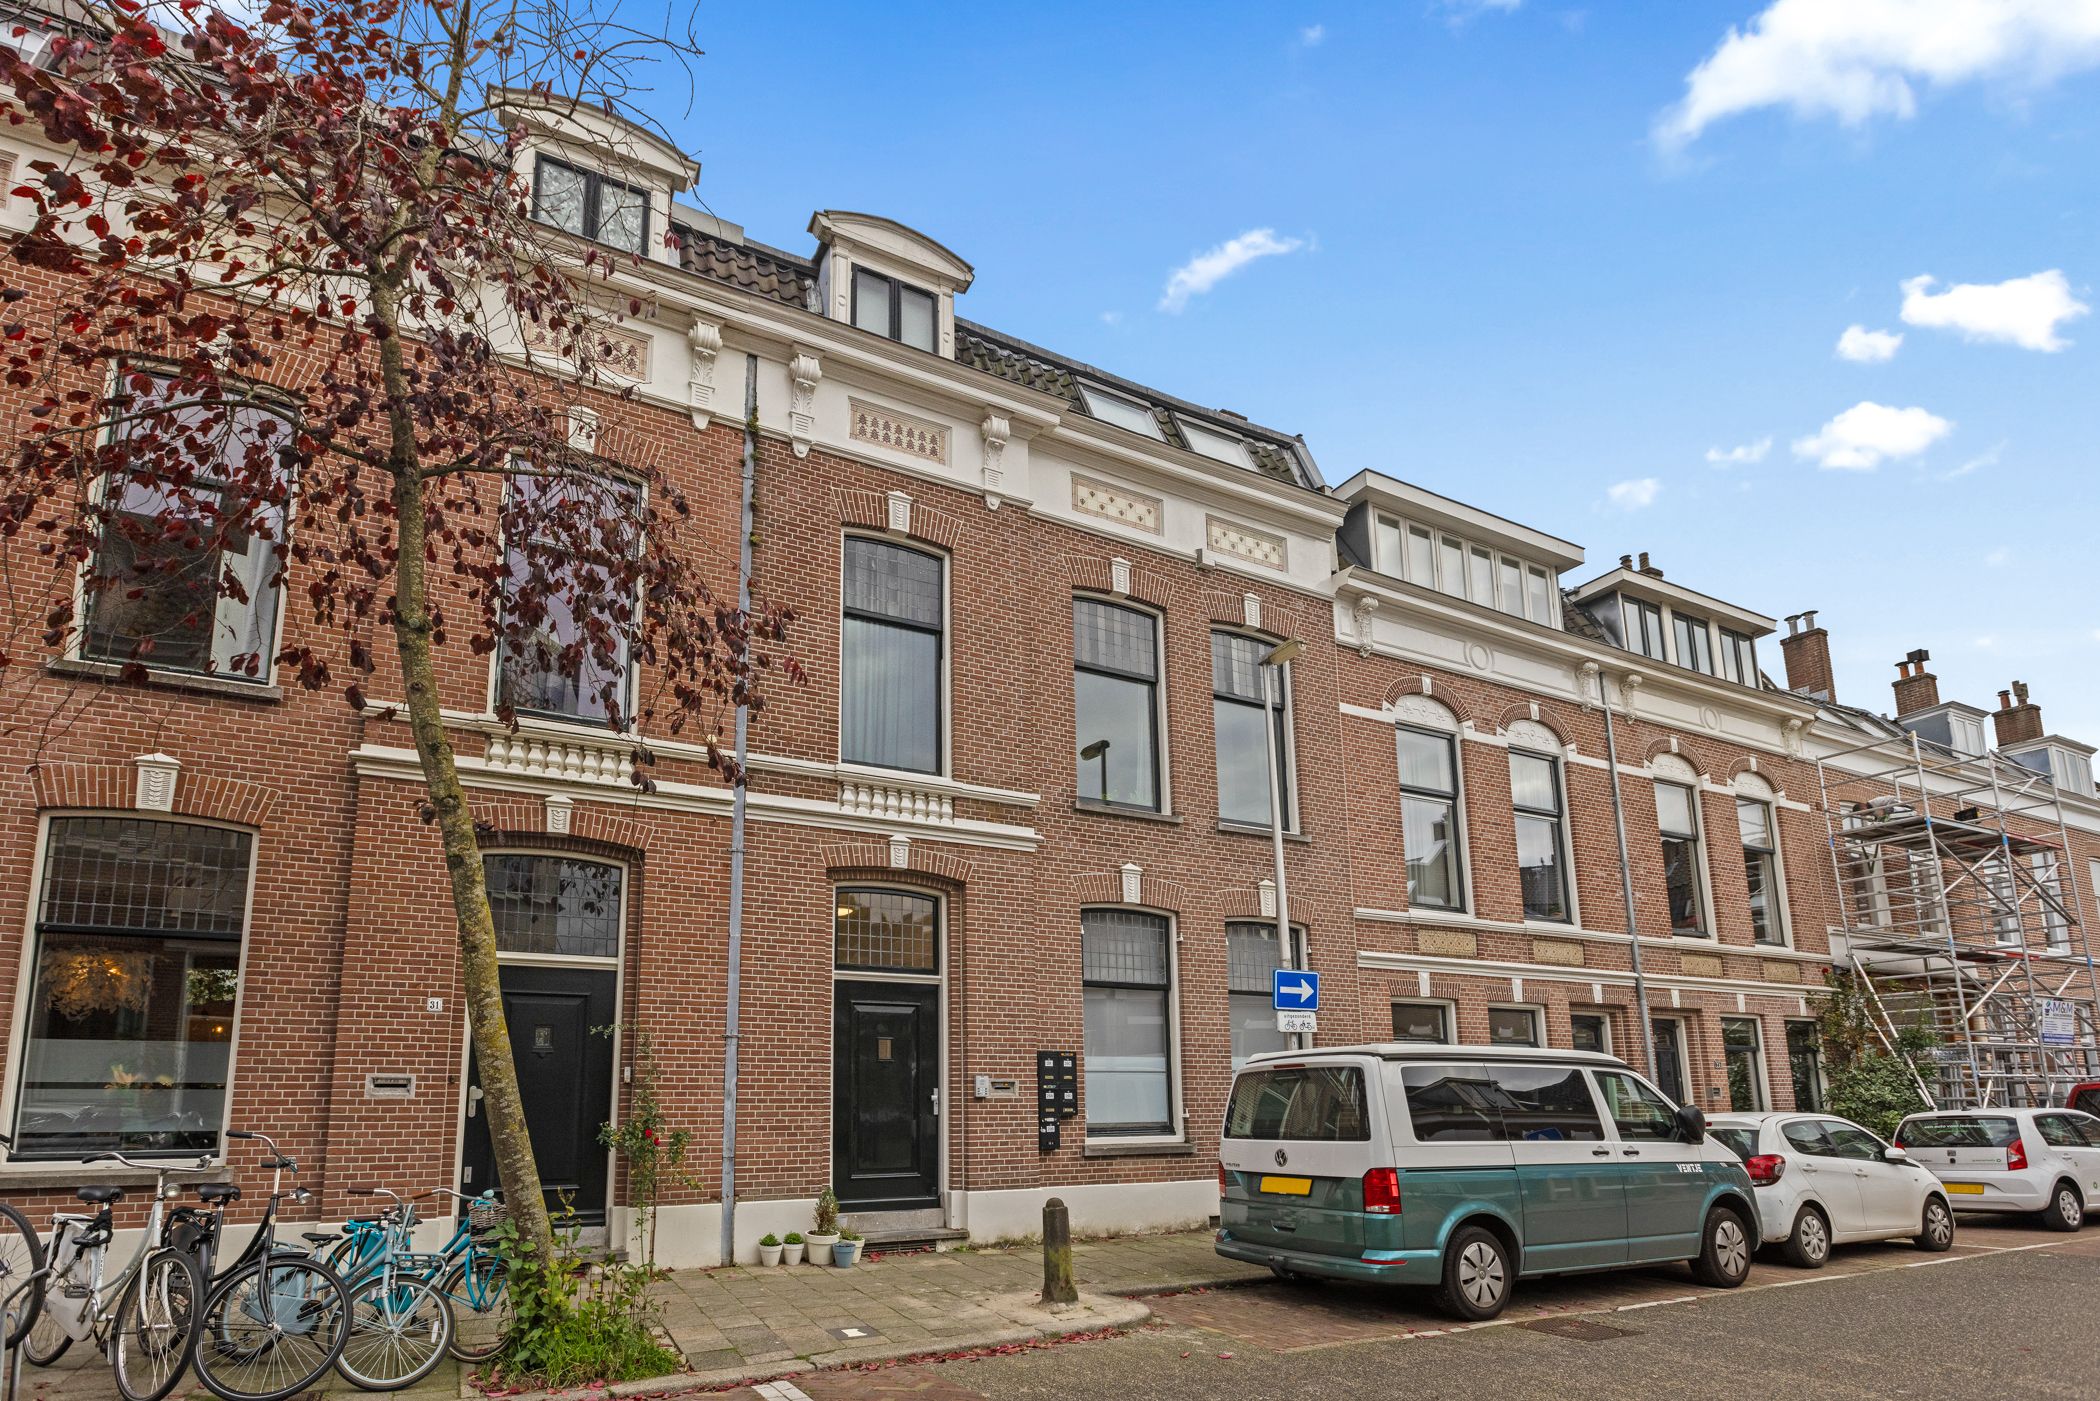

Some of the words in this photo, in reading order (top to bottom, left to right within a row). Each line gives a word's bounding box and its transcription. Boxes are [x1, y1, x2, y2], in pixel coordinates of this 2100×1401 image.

[429, 1000, 439, 1009] 31
[2052, 1001, 2074, 1014] M&M
[1676, 1163, 1703, 1173] VENTJE
